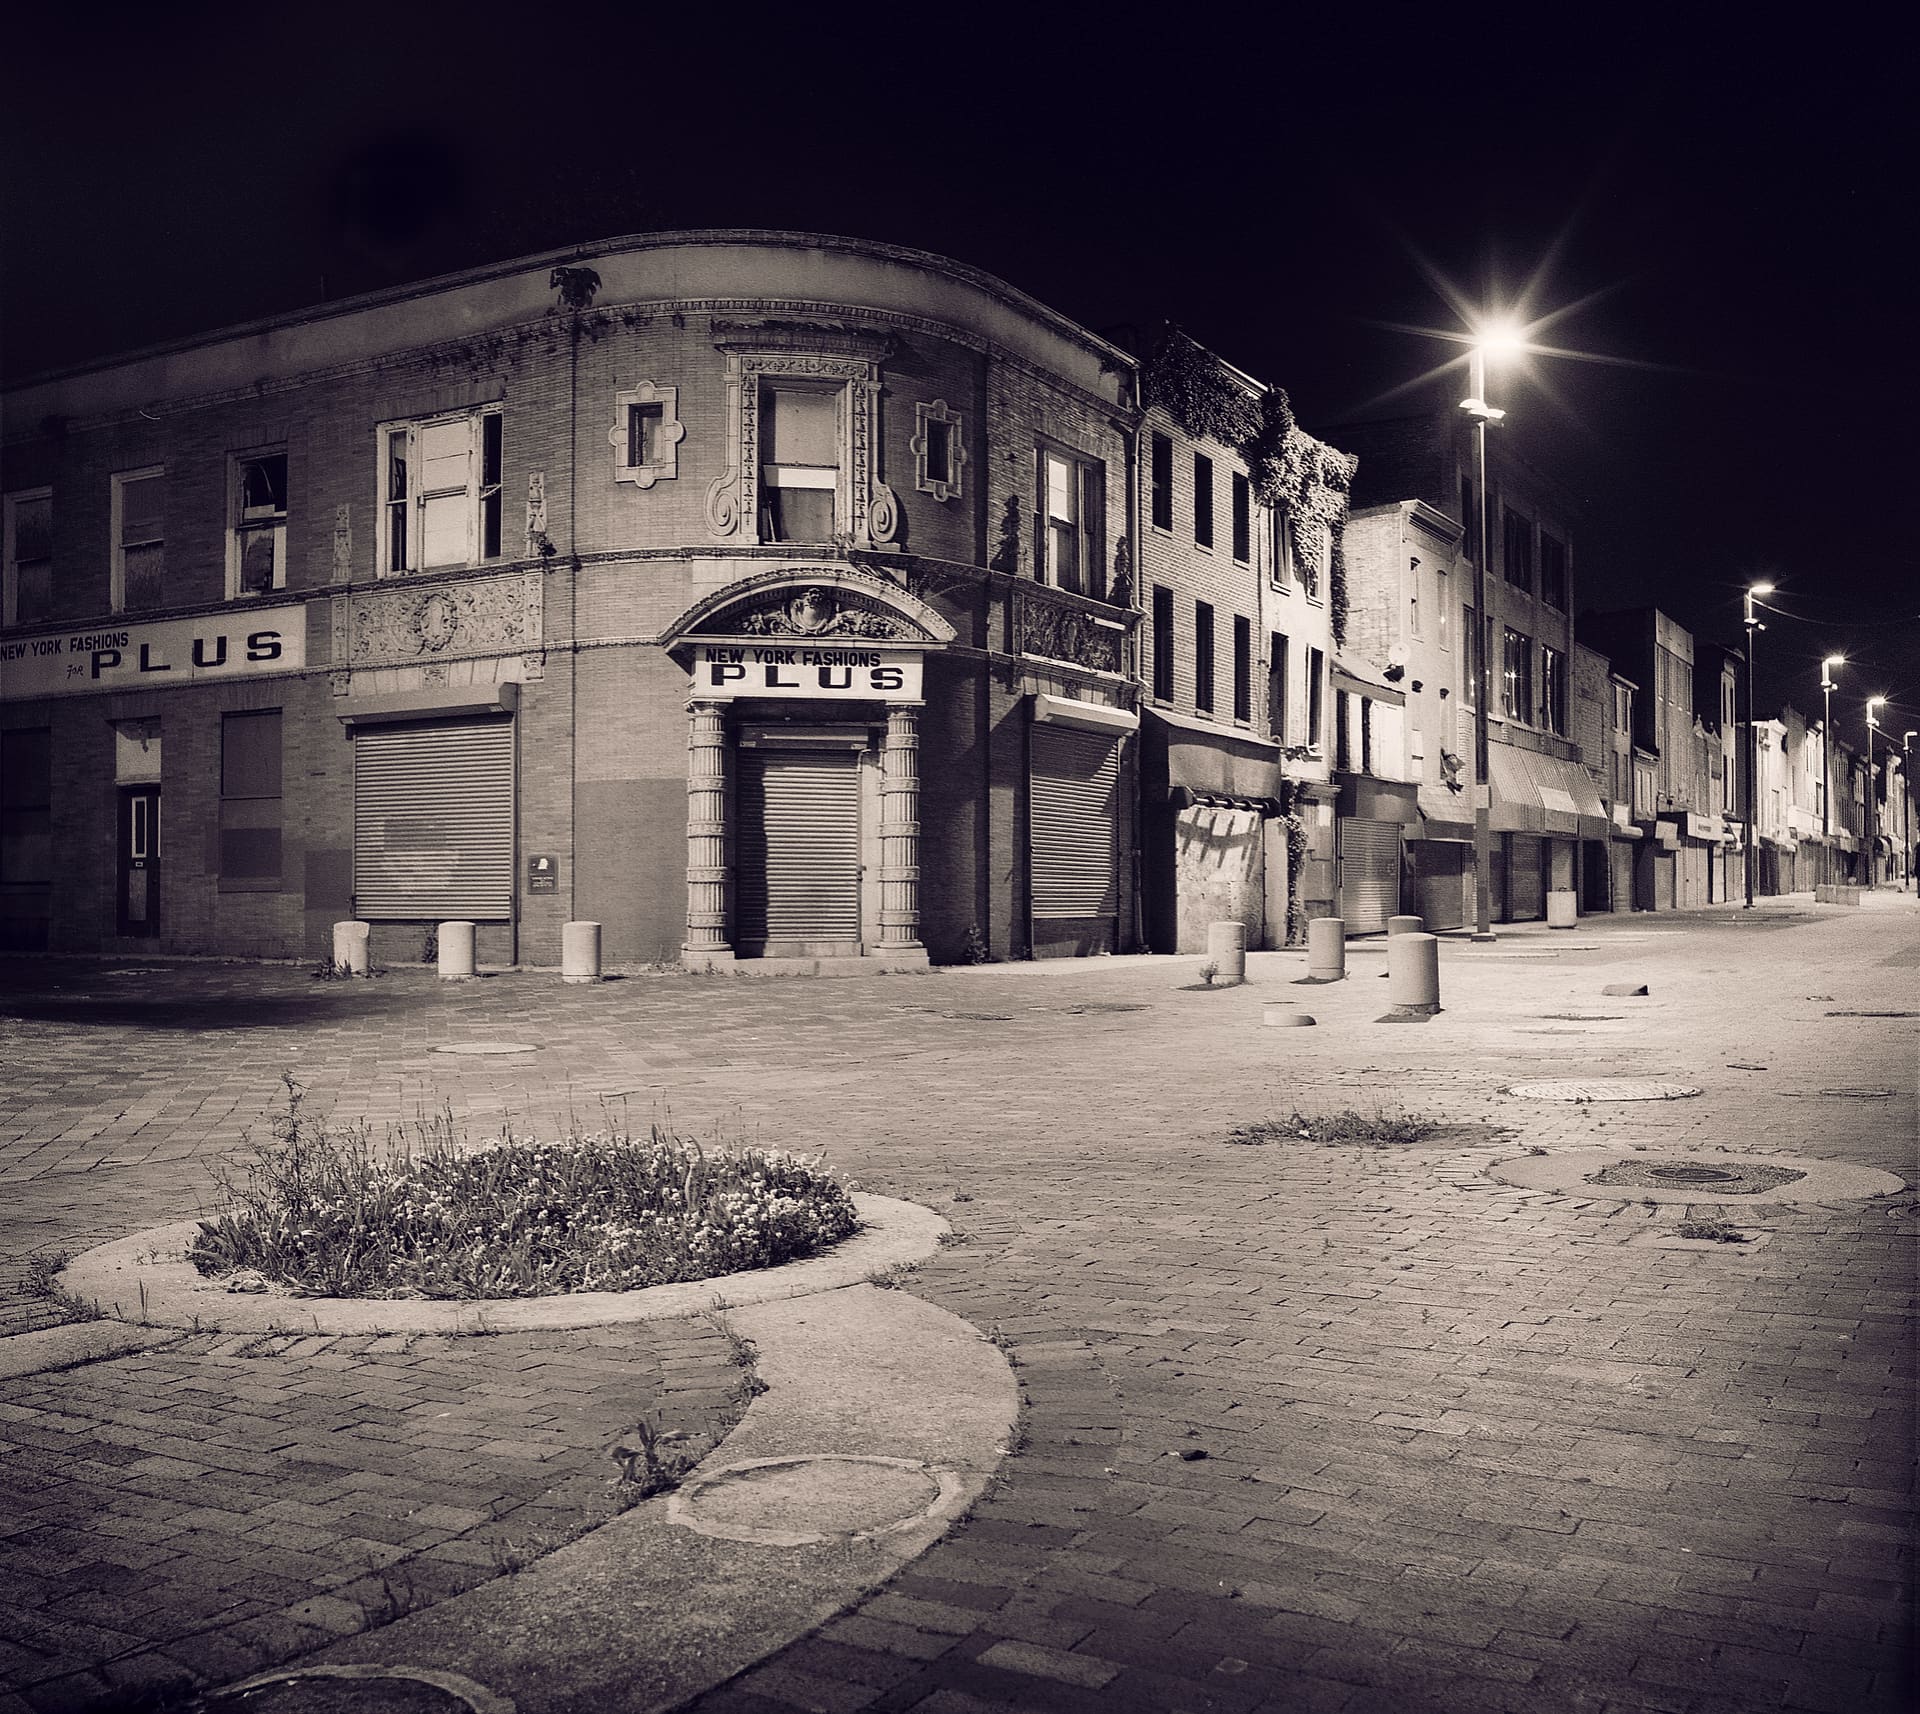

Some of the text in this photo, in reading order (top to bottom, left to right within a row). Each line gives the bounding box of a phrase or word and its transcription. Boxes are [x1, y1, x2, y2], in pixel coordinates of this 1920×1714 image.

[0, 632, 129, 660] NEW YORK FASHIONS
[91, 631, 282, 679] PLUS
[705, 649, 881, 667] NEW YORK FASHIONS
[711, 663, 904, 690] PLUS
